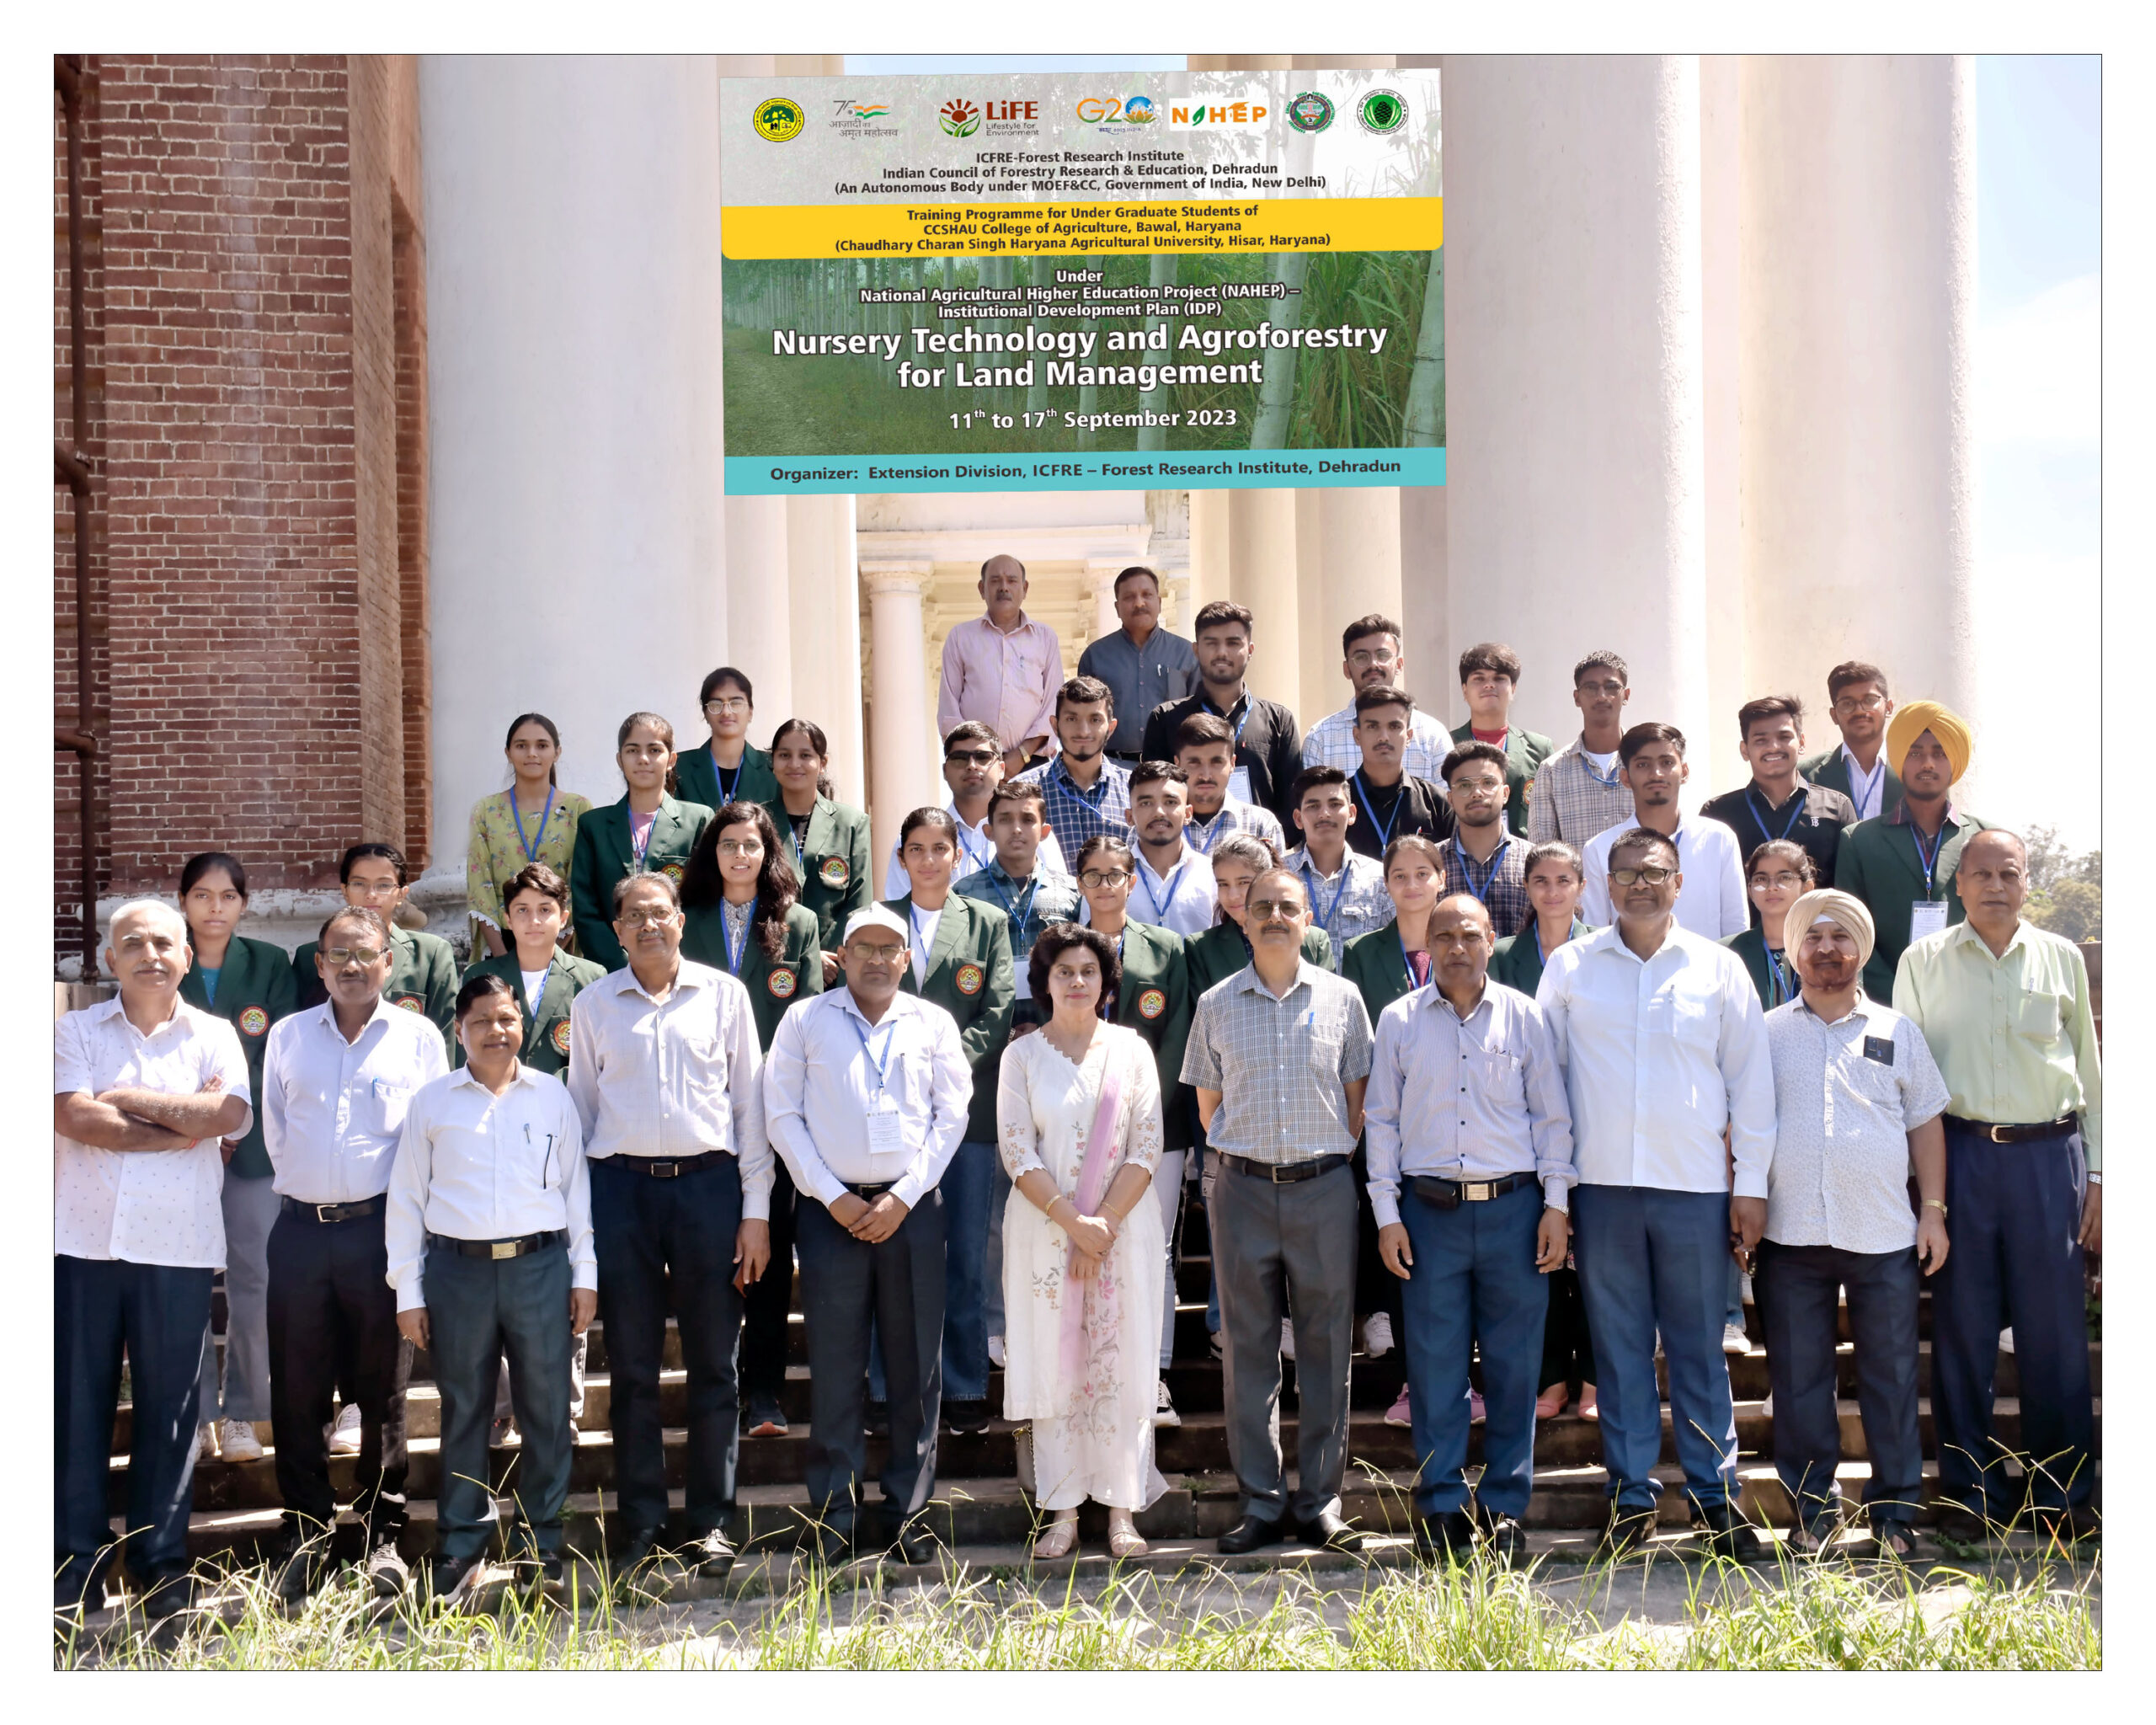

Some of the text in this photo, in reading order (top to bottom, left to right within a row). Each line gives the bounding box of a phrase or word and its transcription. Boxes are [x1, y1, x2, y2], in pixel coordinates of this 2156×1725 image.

[985, 99, 1038, 120] LiFE
[985, 122, 1021, 131] Lifestyle
[976, 150, 1184, 163] ICFRE-Forest Research Institute
[883, 163, 1278, 179] Indian Council of Forestry Research & Education, Dehradun
[835, 176, 1326, 195] (An Autonomous Body under MOEF&CC, Government of India, New Delhi)
[906, 204, 1259, 223] Training Programme for Under Graduate Students of
[923, 220, 1241, 237] CCSHAU College of Agriculture, Bawal, Haryana
[835, 232, 1331, 254] (Chaudhary Charan Singh Haryana Agricultural University, Hisar, Haryana)
[1057, 270, 1103, 282] Under
[861, 288, 926, 302] National
[931, 287, 1022, 304] Agricultural
[1027, 287, 1078, 303] Higher
[1083, 286, 1159, 299] Education
[1164, 285, 1217, 301] Project
[1222, 284, 1285, 299] (NAHEP)
[939, 302, 1221, 319] Institutional Development Plan (IDP)
[774, 322, 1387, 360] Nursery Technology and Agroforestry
[897, 360, 1262, 392] for Land Management
[991, 414, 1013, 428] to
[1065, 409, 1180, 432] September
[1187, 409, 1236, 425] 2023
[770, 467, 858, 483] Organizer:
[868, 466, 950, 479] Extension
[955, 465, 1027, 479] Division,
[1033, 463, 1083, 477] ICFRE
[1102, 463, 1154, 476] Forest
[1159, 461, 1233, 476] Research
[1238, 462, 1313, 475] Institute,
[1318, 459, 1401, 473] Dehradun
